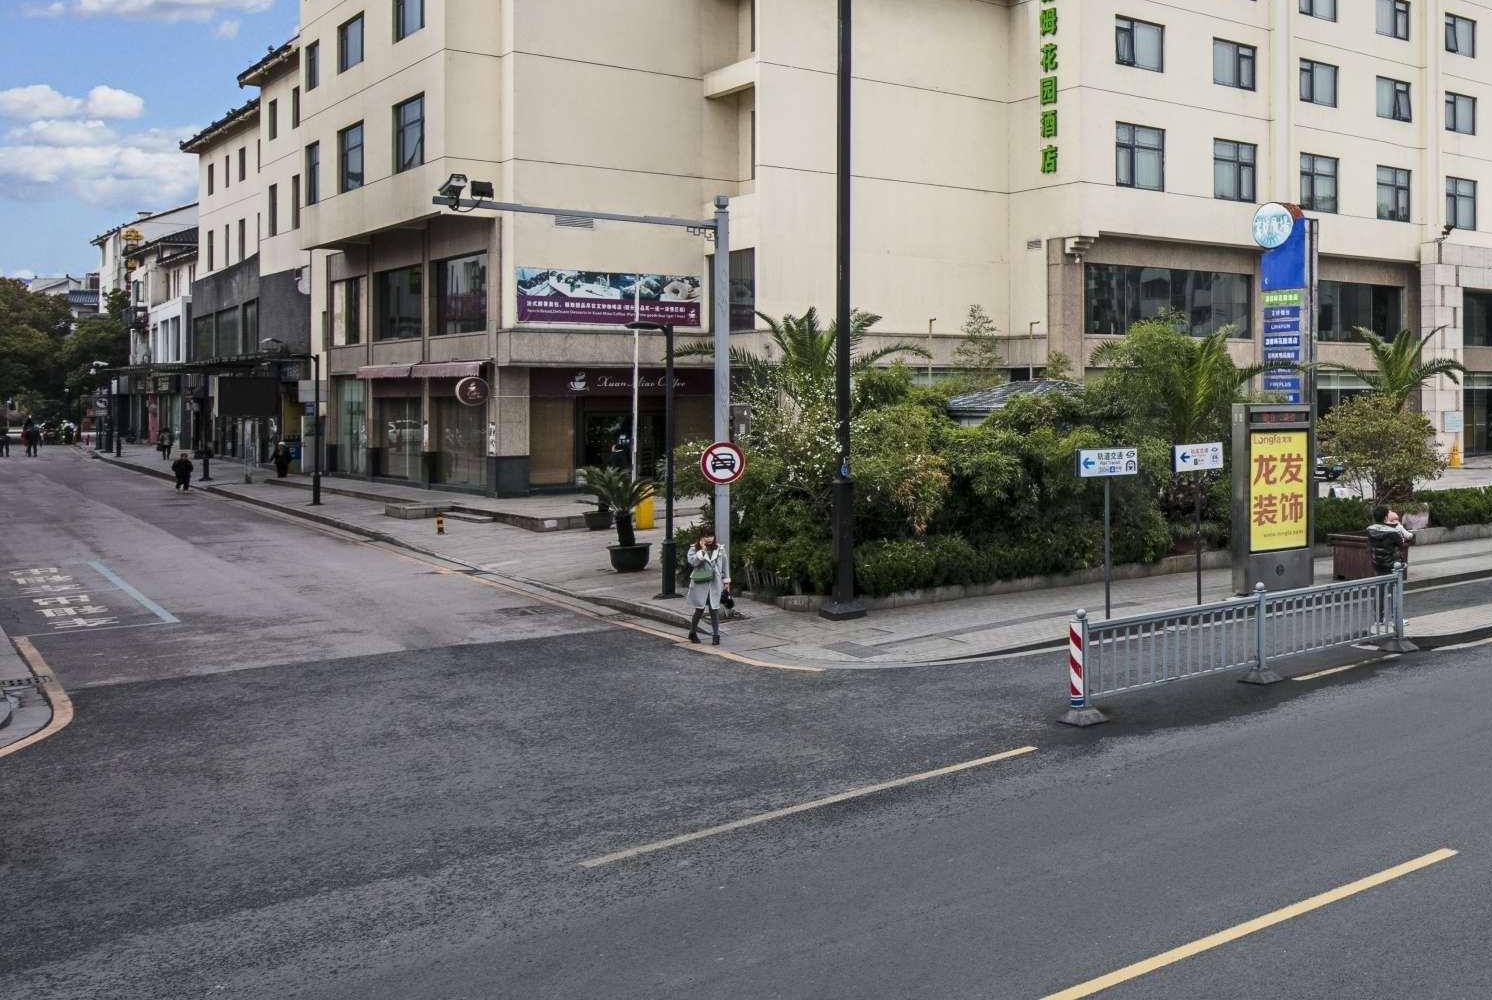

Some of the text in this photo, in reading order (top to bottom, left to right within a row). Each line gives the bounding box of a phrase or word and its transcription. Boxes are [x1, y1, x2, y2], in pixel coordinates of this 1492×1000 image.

[597, 375, 627, 387] Xuan
[1254, 453, 1304, 486] 龙发
[1254, 491, 1304, 526] 装饰
